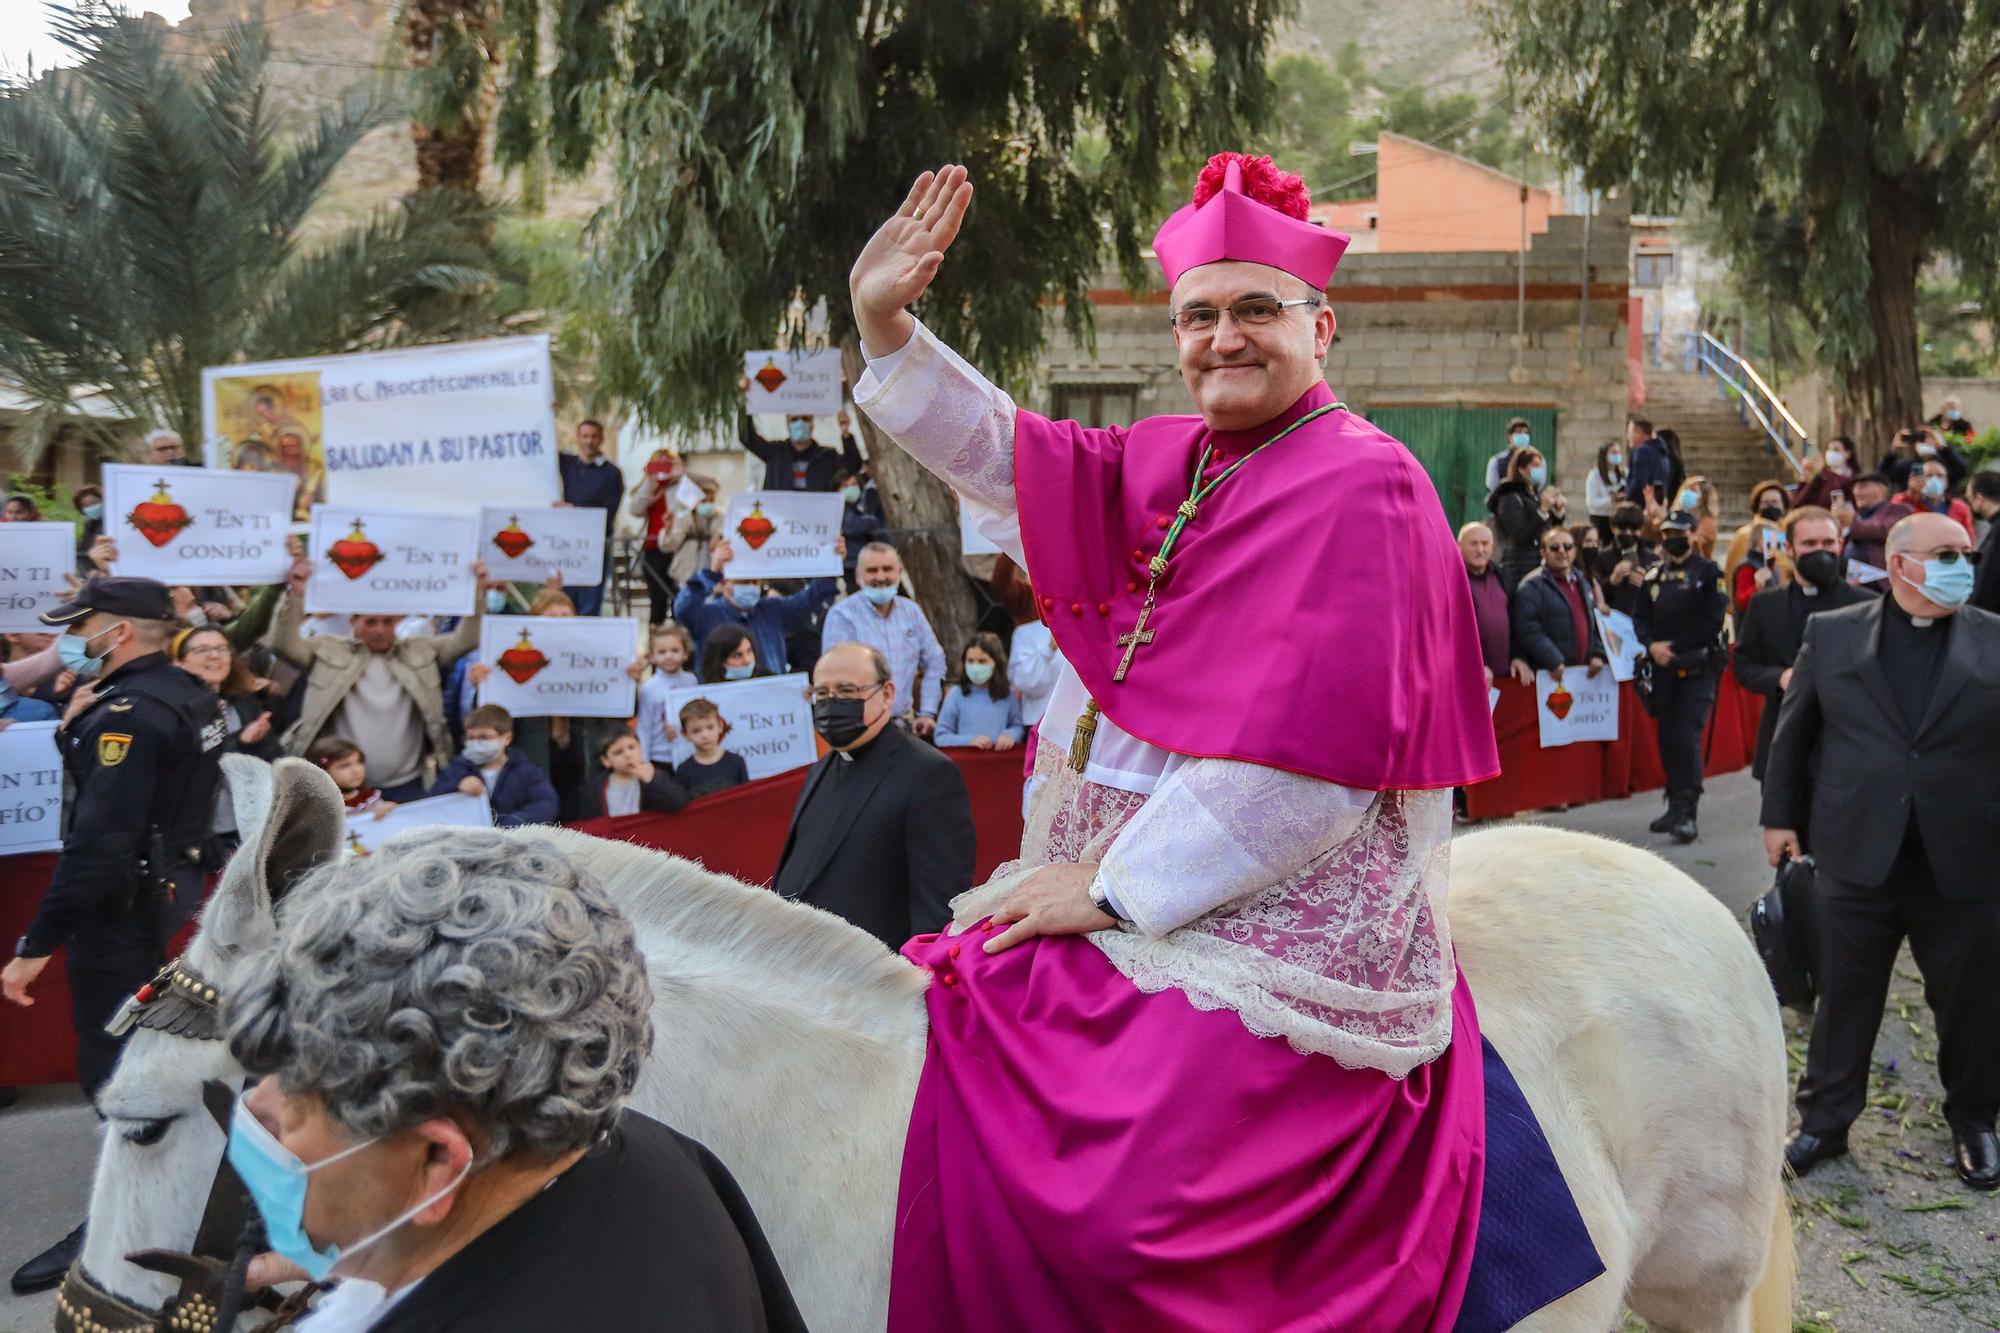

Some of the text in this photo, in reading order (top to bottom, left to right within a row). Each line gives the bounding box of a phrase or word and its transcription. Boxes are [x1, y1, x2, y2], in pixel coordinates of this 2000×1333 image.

[326, 429, 545, 472] SALUDAN A SU PASTOR
[251, 513, 271, 529] TI
[27, 567, 51, 581] TI
[778, 712, 795, 727] TI
[737, 733, 798, 758] ONFÍO”
[30, 769, 59, 787] TI
